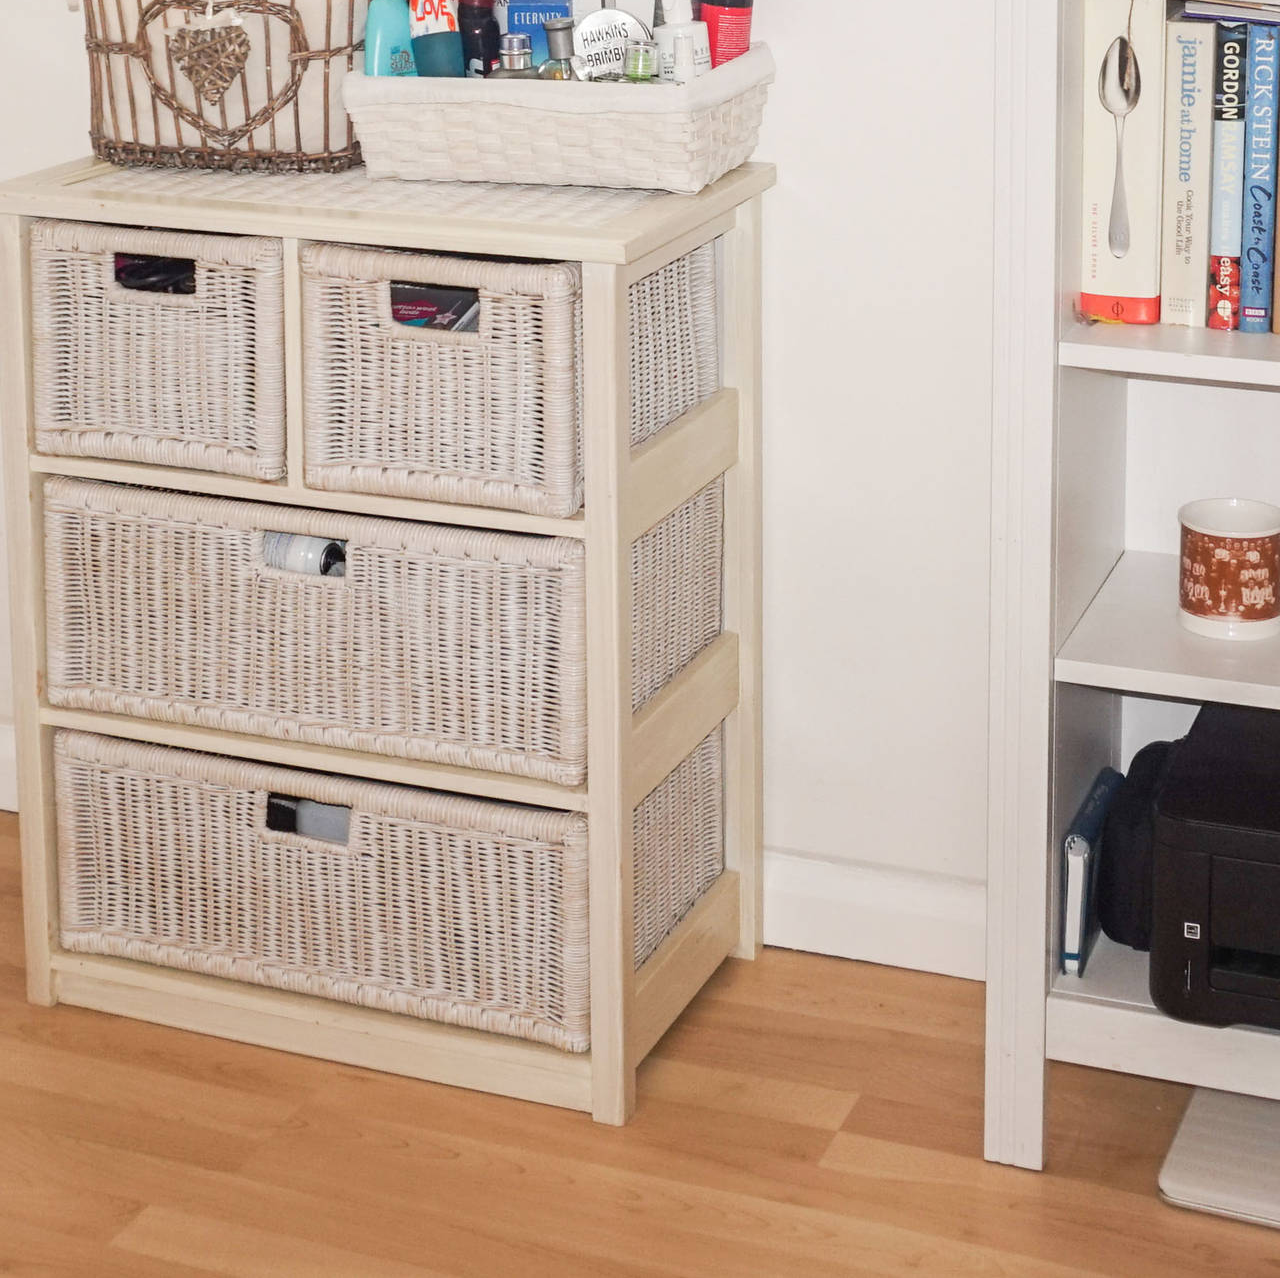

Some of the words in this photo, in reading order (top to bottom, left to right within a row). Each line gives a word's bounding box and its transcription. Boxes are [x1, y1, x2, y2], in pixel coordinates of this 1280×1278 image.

[582, 22, 629, 49] HAWKINS
[1178, 35, 1203, 107] jamie
[1222, 42, 1240, 120] GORDON
[1253, 37, 1274, 99] RICK
[1181, 110, 1193, 125] at
[1250, 105, 1272, 181] STEIN
[1179, 127, 1197, 183] home
[1249, 185, 1272, 235] Coast
[1216, 257, 1233, 296] easy
[1246, 246, 1267, 296] Coast
